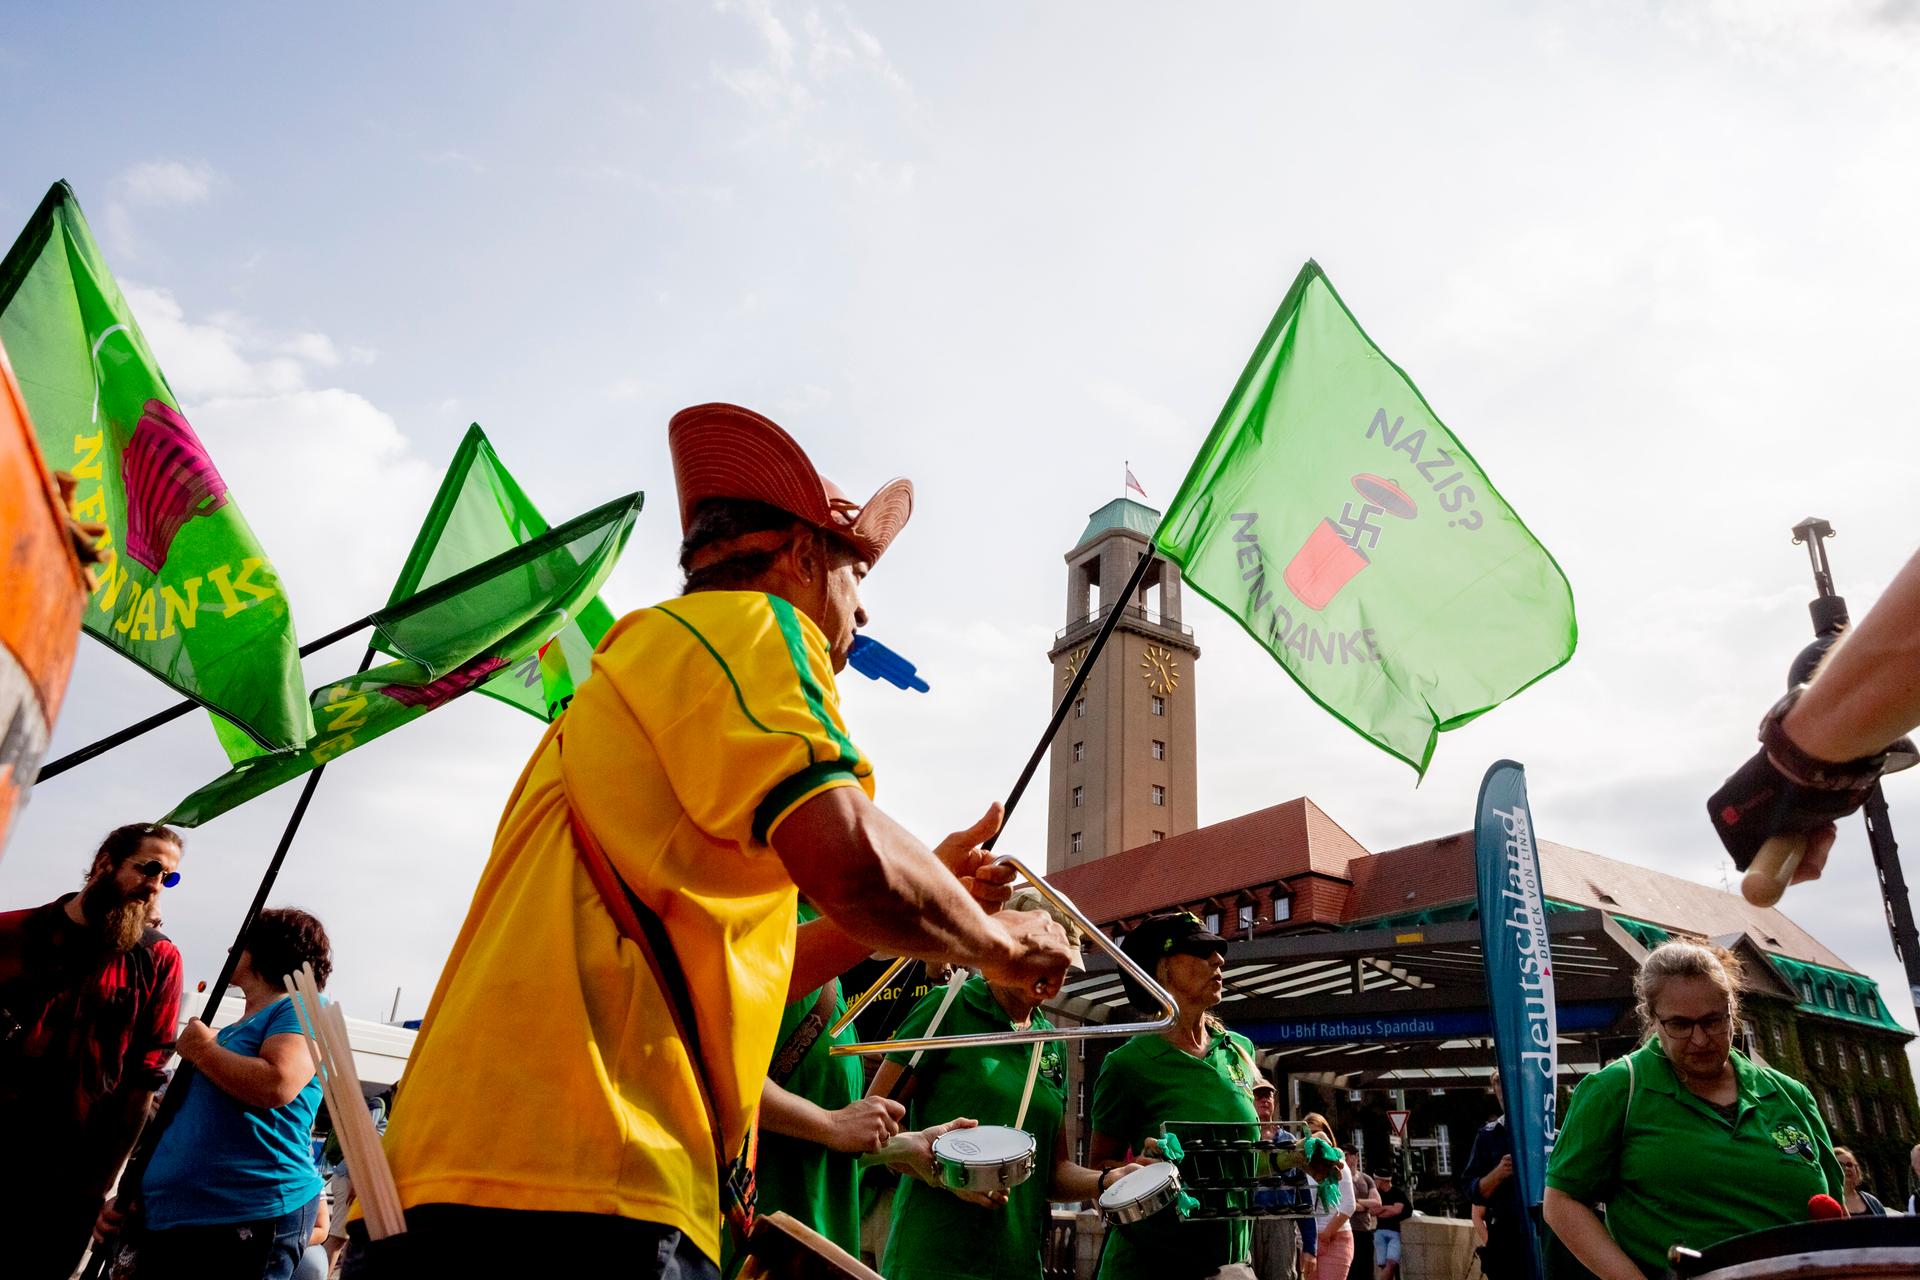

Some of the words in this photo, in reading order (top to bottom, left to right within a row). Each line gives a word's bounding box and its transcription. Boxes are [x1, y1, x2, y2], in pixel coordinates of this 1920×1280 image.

[1365, 407, 1484, 532] NAZIS?
[1230, 512, 1274, 613] NEIN
[1269, 604, 1382, 665] DANKE
[1516, 816, 1531, 861] LINKS
[1524, 868, 1538, 899] VON
[1492, 807, 1556, 1080] deutschland
[1531, 906, 1549, 960] DRUCK
[1281, 1023, 1317, 1039] U-Bhf
[1320, 1021, 1373, 1037] Rathaus
[1376, 1018, 1435, 1037] Spandau
